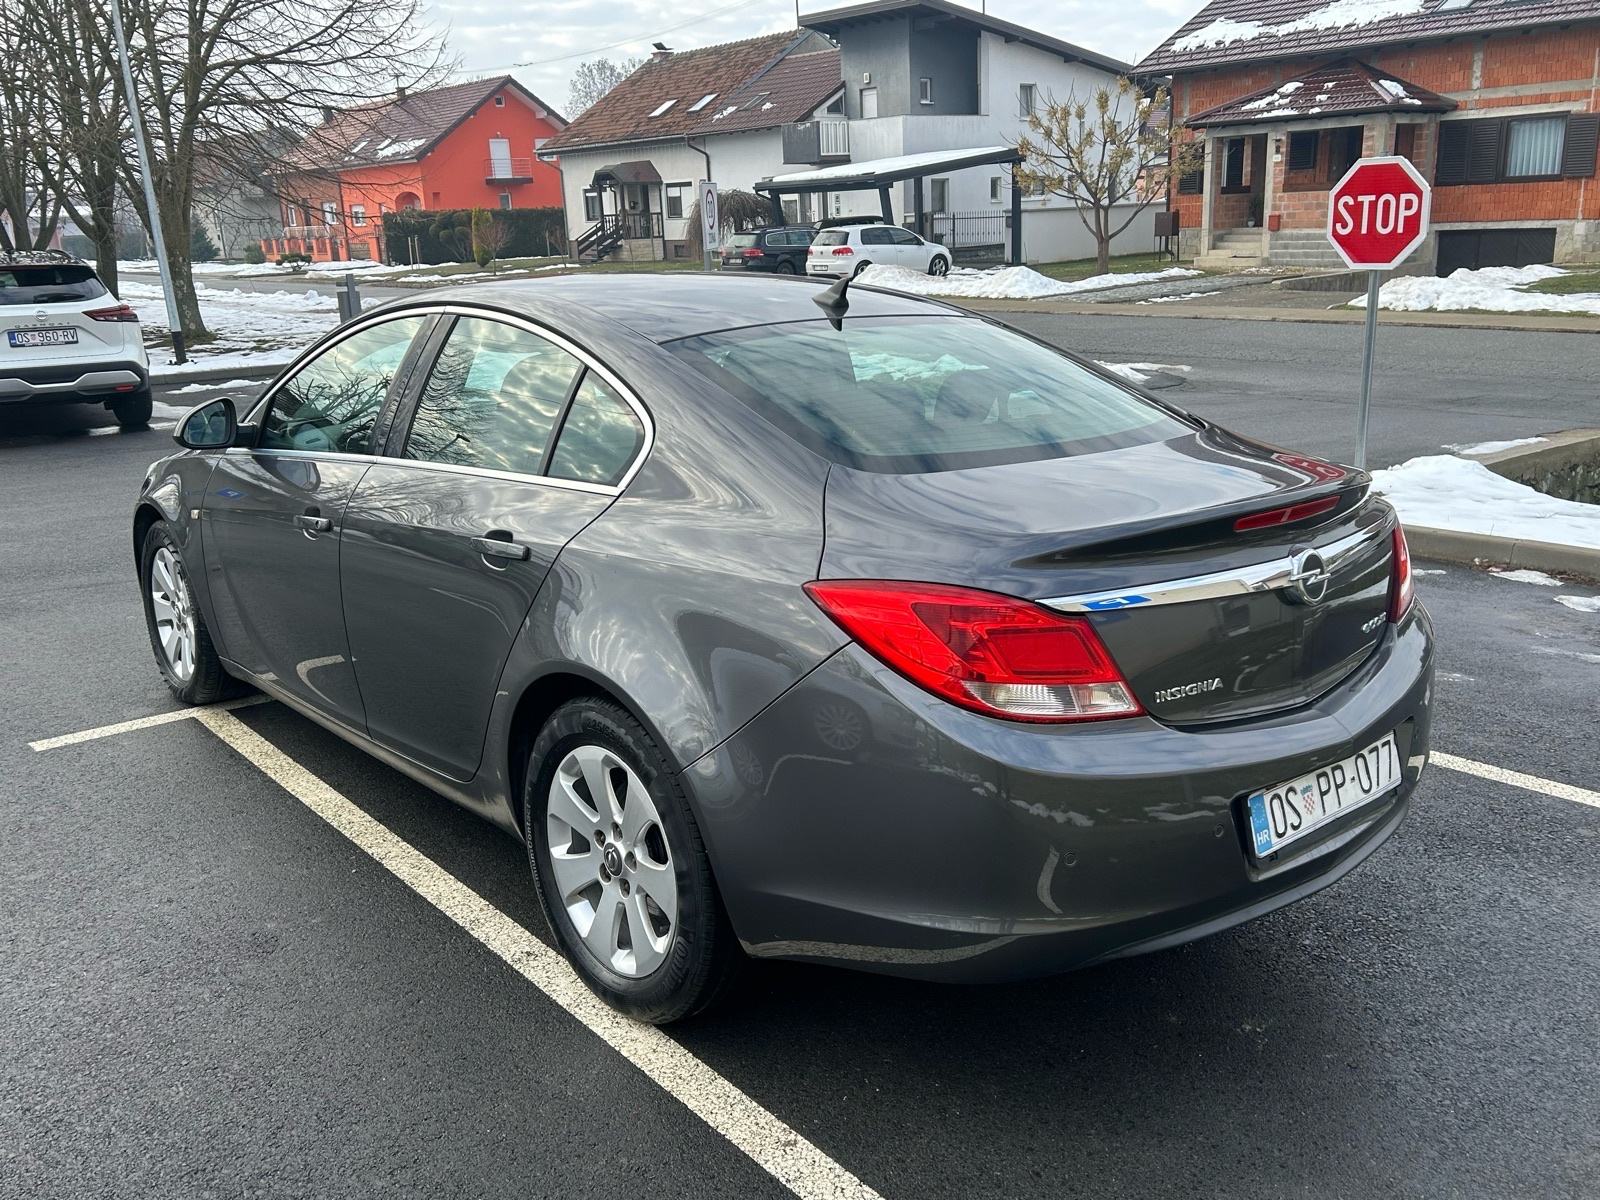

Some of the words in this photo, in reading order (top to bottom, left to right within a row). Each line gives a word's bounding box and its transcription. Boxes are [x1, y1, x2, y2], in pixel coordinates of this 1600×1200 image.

[1335, 193, 1419, 235] STOP
[17, 332, 30, 343] OS
[38, 330, 75, 342] 960-RV
[1154, 677, 1224, 703] INSIGNIA
[1269, 786, 1302, 839] OS
[1316, 739, 1392, 816] PP-077
[1256, 829, 1270, 845] HR
